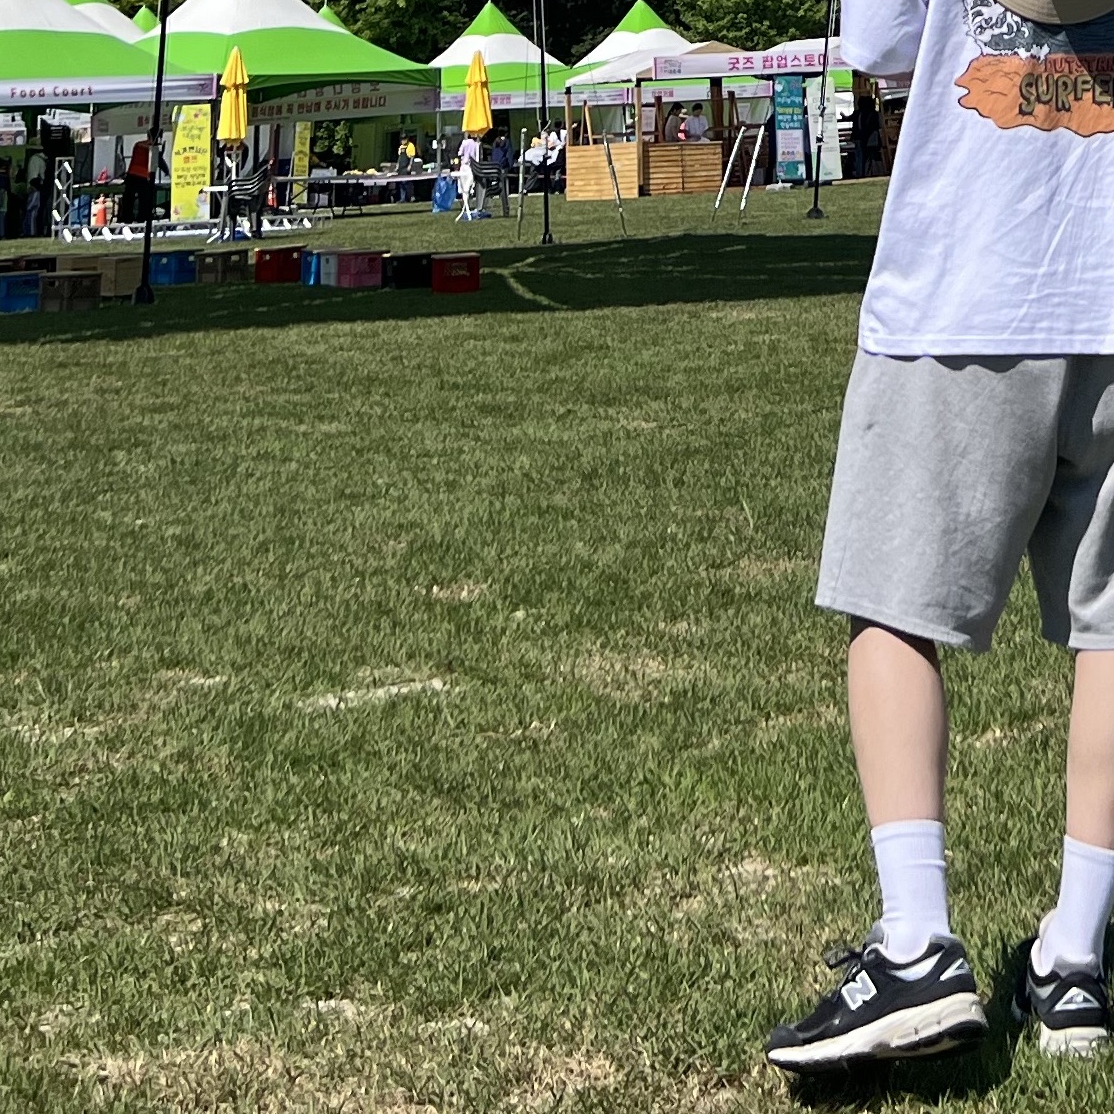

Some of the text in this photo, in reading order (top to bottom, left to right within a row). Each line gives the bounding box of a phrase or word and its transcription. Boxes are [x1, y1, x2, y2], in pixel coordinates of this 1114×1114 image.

[728, 56, 755, 71] 굿즈
[10, 86, 93, 99] Food Court
[325, 98, 350, 111] 주시기
[352, 95, 387, 109] 바랍니다
[841, 969, 878, 1011] N
